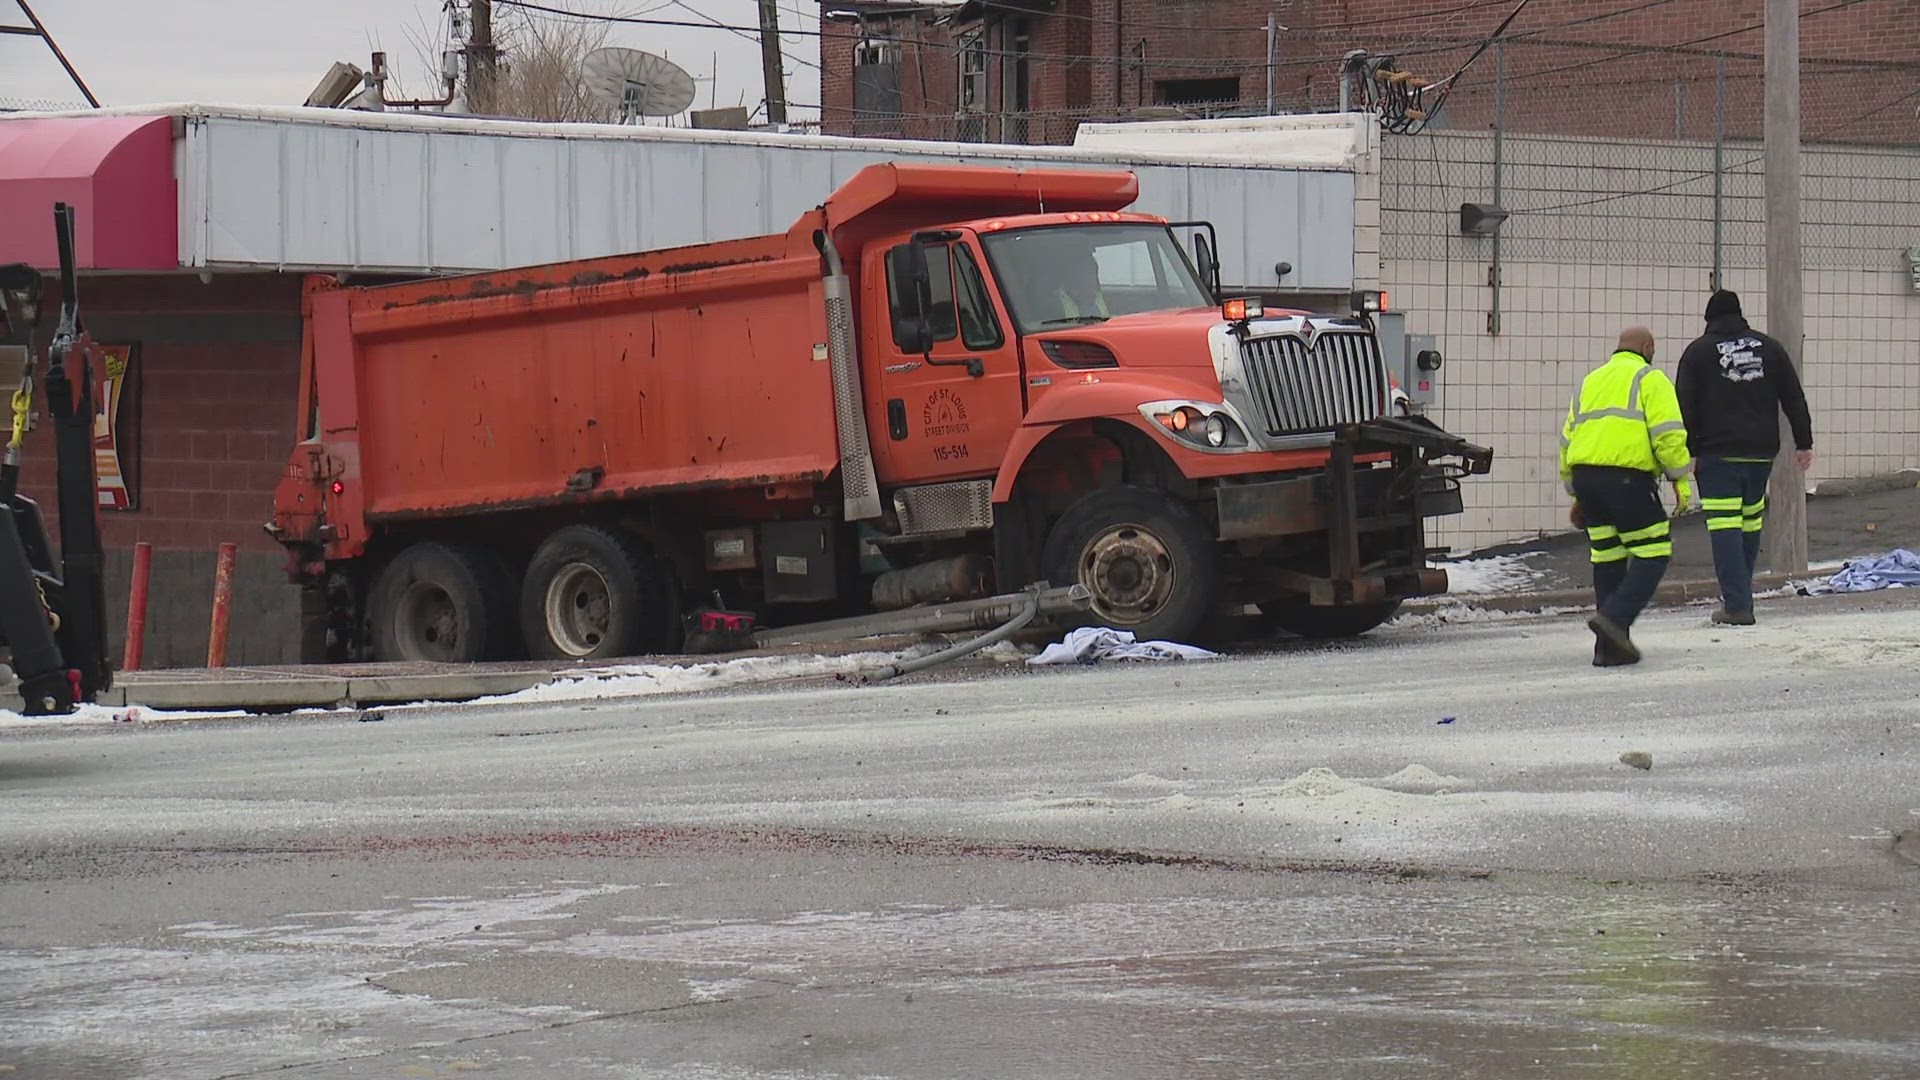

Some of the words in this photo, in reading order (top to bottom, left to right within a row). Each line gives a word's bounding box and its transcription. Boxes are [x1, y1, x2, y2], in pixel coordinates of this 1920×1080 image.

[924, 403, 932, 425] CITY
[929, 391, 938, 404] OF
[939, 389, 950, 399] ST.
[951, 392, 967, 419] LOUIS
[924, 426, 945, 438] STREET
[946, 423, 970, 435] DIVISION
[934, 444, 969, 461] 115-514
